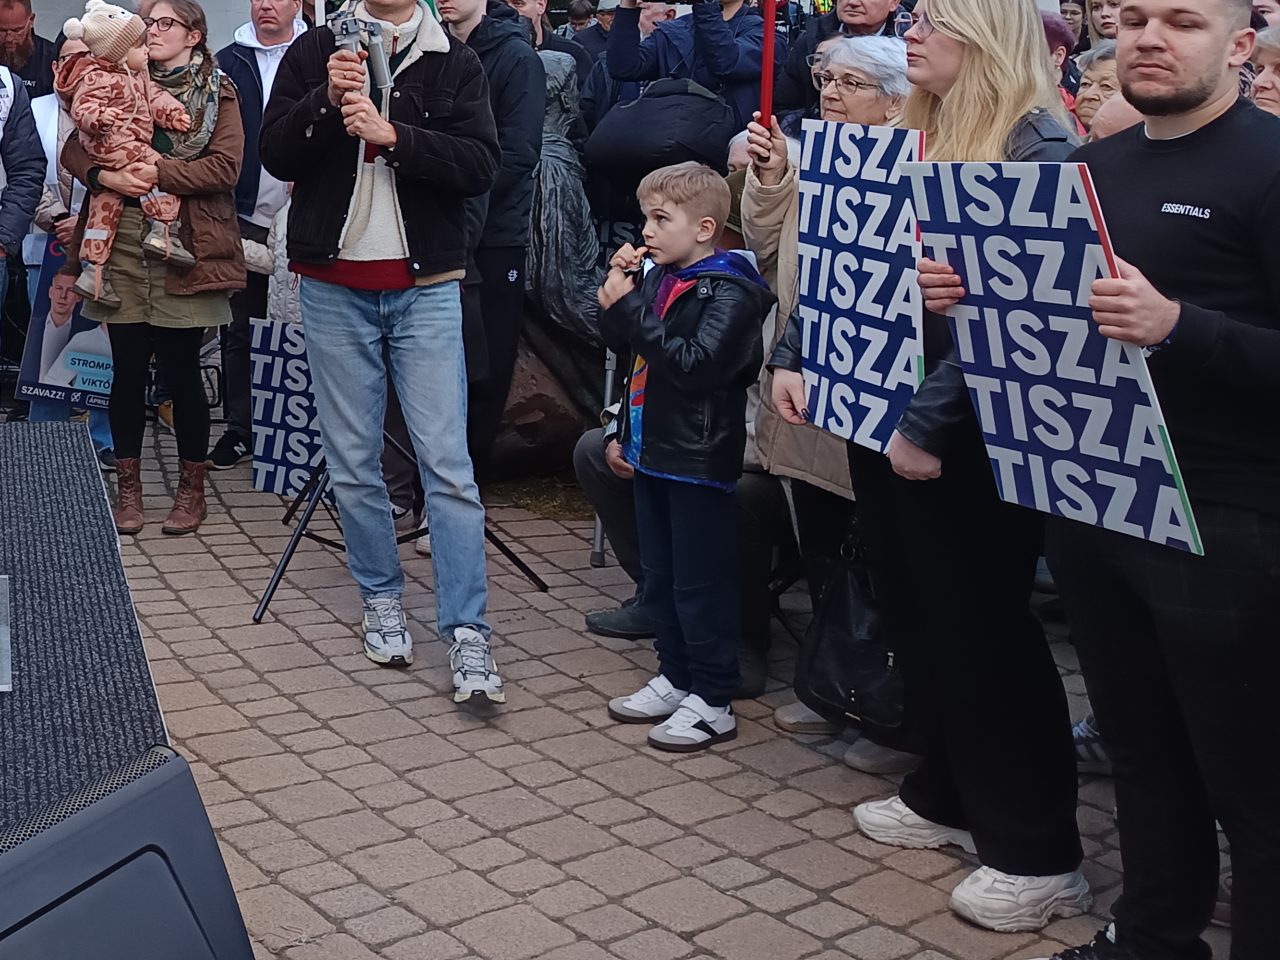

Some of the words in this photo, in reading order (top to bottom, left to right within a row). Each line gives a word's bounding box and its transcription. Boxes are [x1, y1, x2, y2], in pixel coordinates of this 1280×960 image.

[801, 118, 920, 184] TISZA
[799, 180, 920, 258] TISZA
[899, 162, 1098, 231] TISZA
[1161, 203, 1211, 219] ESSENTIALS
[798, 242, 920, 328] TISZA
[920, 232, 1110, 308] TISZA
[250, 352, 313, 392] TIS
[799, 304, 920, 394] TISZA
[945, 304, 1149, 393] TISZA
[21, 385, 65, 400] SZAVAZZ!
[802, 367, 900, 454] TISZ
[963, 373, 1173, 474] TISZA
[253, 460, 322, 499] TIS
[985, 444, 1197, 553] TISZA
